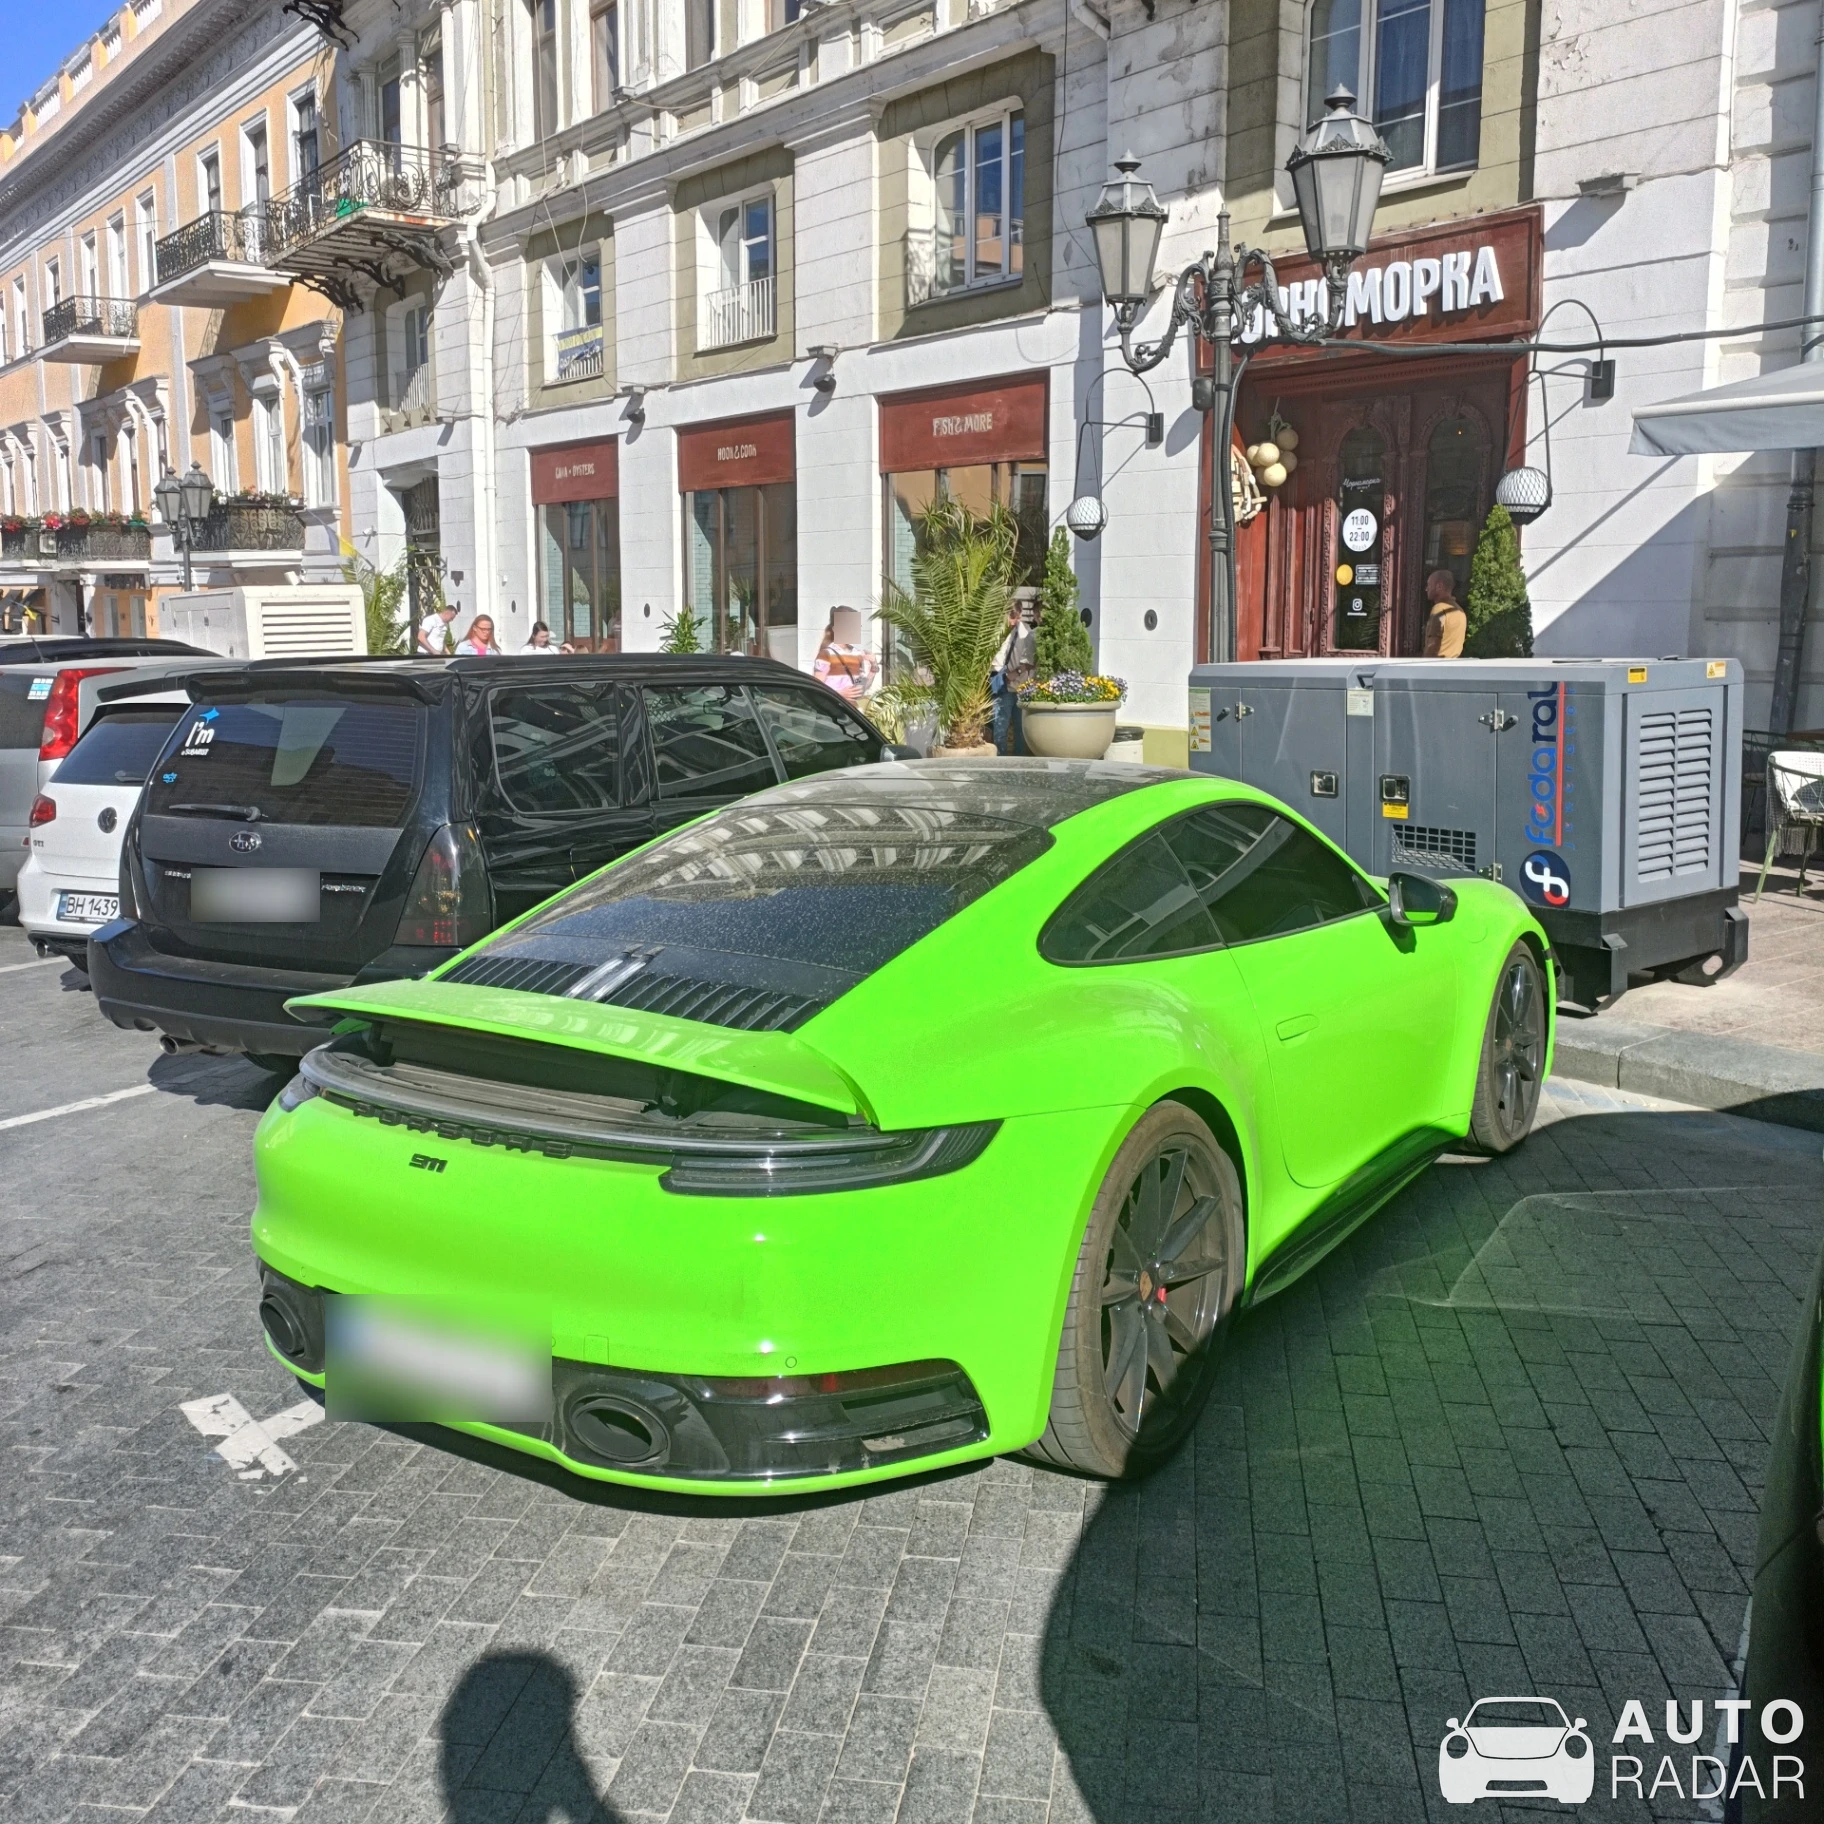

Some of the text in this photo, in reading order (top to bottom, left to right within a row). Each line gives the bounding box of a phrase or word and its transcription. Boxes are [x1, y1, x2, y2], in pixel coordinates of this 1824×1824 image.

[964, 412, 992, 433] MORE
[1351, 515, 1369, 526] 11:00
[1349, 531, 1370, 542] 22:00
[66, 896, 119, 917] BH 1439
[353, 1101, 574, 1160] PORSCHE
[408, 1153, 448, 1174] 911
